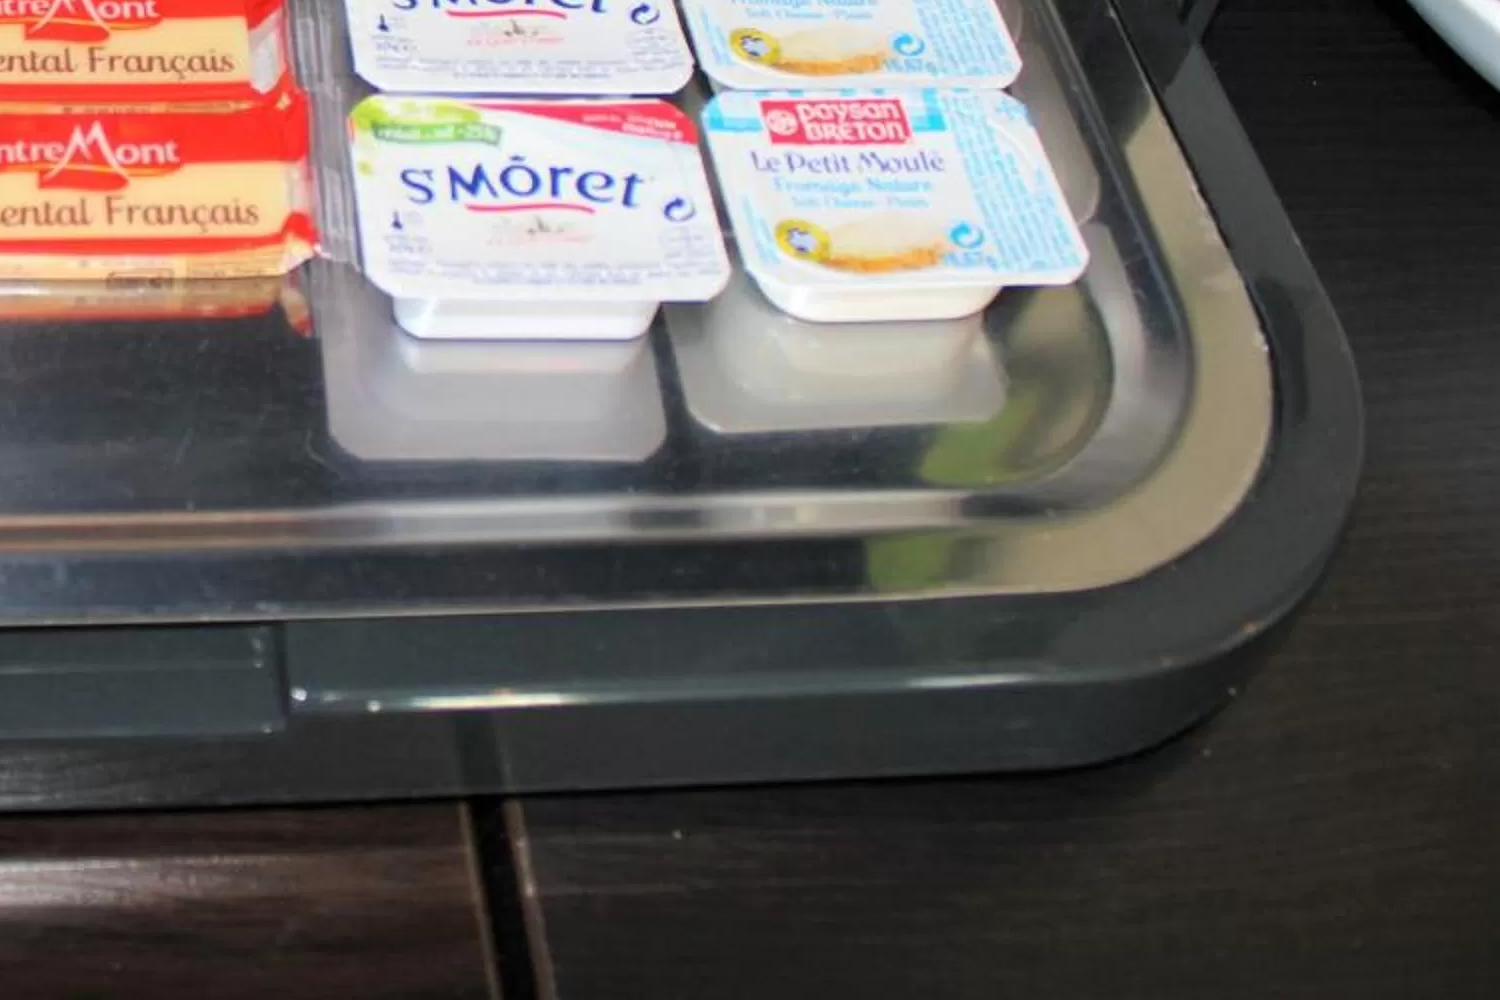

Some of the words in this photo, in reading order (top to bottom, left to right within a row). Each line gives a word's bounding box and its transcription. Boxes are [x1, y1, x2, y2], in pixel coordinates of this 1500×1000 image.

[88, 45, 236, 81] Français
[750, 149, 782, 170] Le
[786, 154, 850, 174] Petit
[855, 151, 945, 173] Moulé
[104, 197, 260, 233] Français
